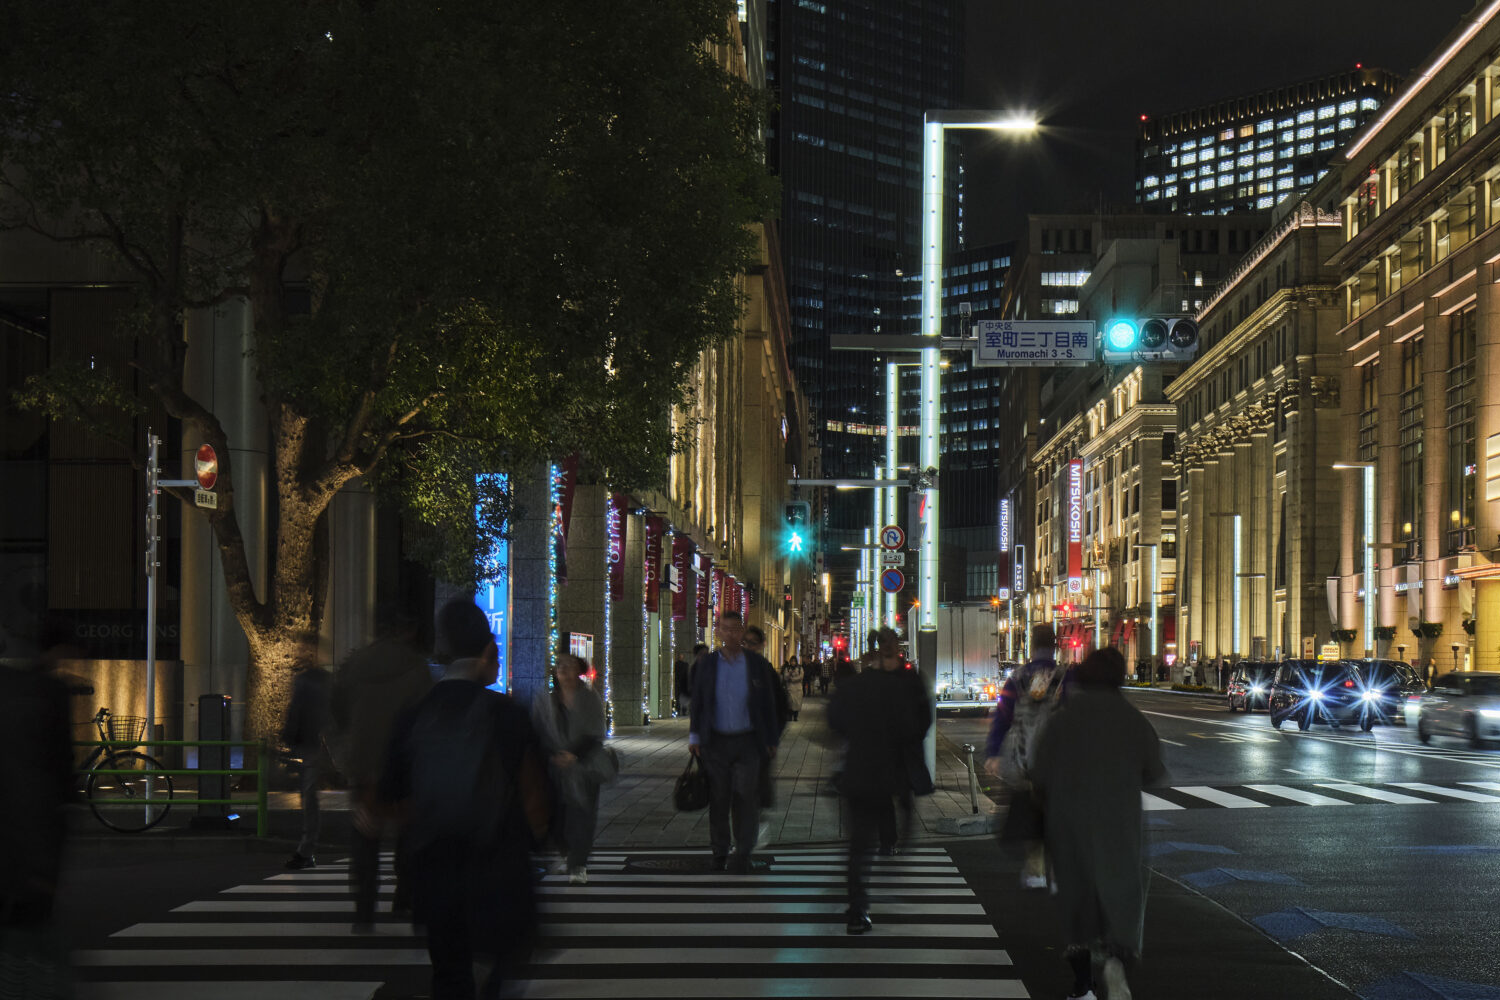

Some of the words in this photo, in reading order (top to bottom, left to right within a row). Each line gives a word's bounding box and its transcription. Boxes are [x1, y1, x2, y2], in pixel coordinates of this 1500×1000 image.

[985, 322, 1013, 331] 中央区
[985, 331, 1088, 348] 室町三丁目南
[997, 349, 1049, 358] Muromachi
[1070, 463, 1081, 543] MITSUKOSHI
[610, 508, 621, 563] YUITO
[1001, 498, 1009, 552] MITSUKOSHI
[647, 534, 657, 581] YUITO
[75, 624, 134, 638] GEORG
